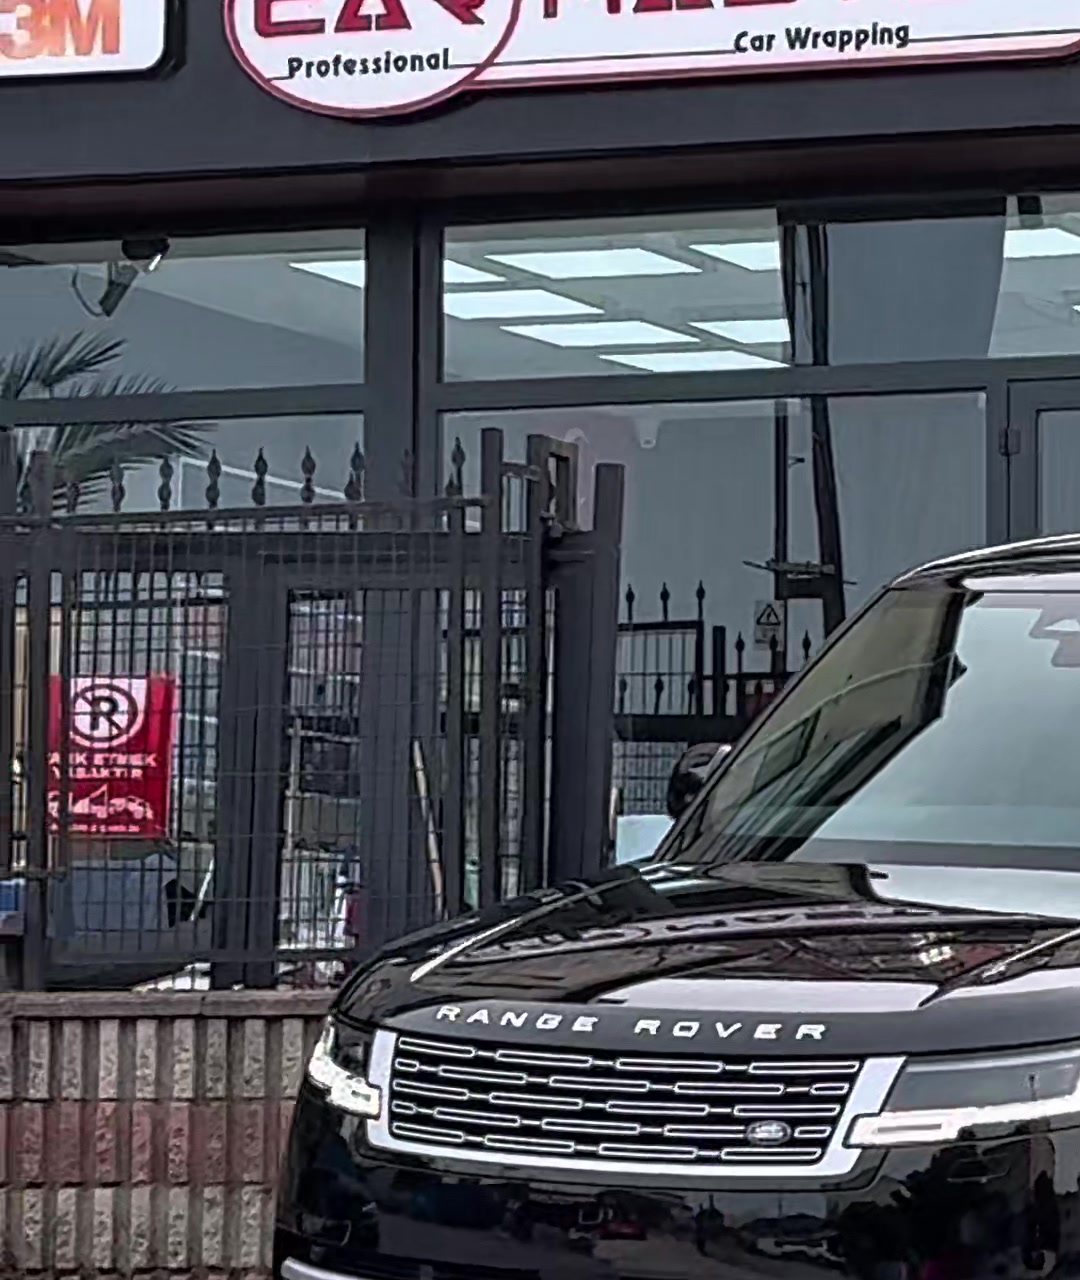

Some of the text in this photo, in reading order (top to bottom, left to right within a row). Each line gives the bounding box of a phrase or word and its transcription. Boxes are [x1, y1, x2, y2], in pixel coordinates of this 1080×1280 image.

[733, 22, 910, 54] Car Wrapping
[286, 47, 450, 80] Professional
[436, 1005, 827, 1040] RANGE ROVER
